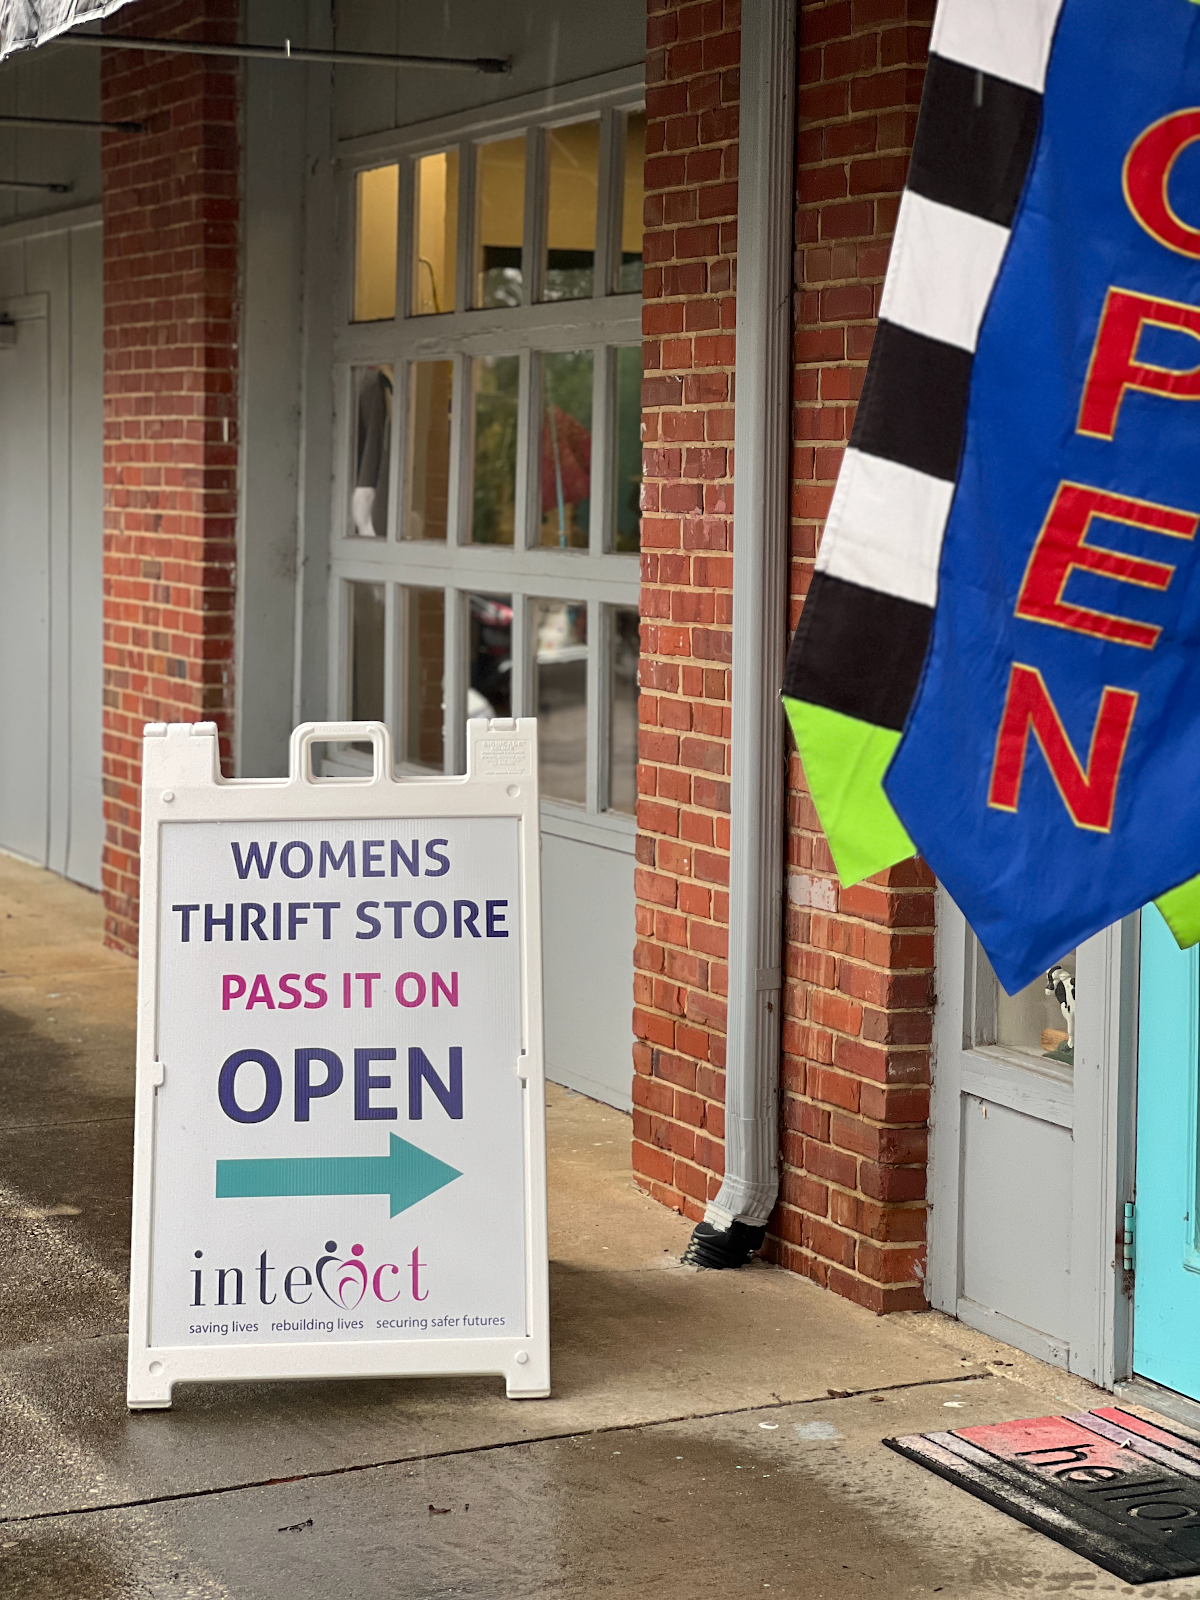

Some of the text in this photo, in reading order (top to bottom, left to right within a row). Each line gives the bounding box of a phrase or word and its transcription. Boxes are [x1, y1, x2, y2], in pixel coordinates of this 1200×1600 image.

[230, 838, 451, 880] WOMENS
[171, 899, 510, 943] THRIFT STORE
[222, 971, 459, 1011] PASS IT ON
[217, 1046, 464, 1125] OPEN
[189, 1314, 506, 1336] saving lives rebuilding lives securing safer futures
